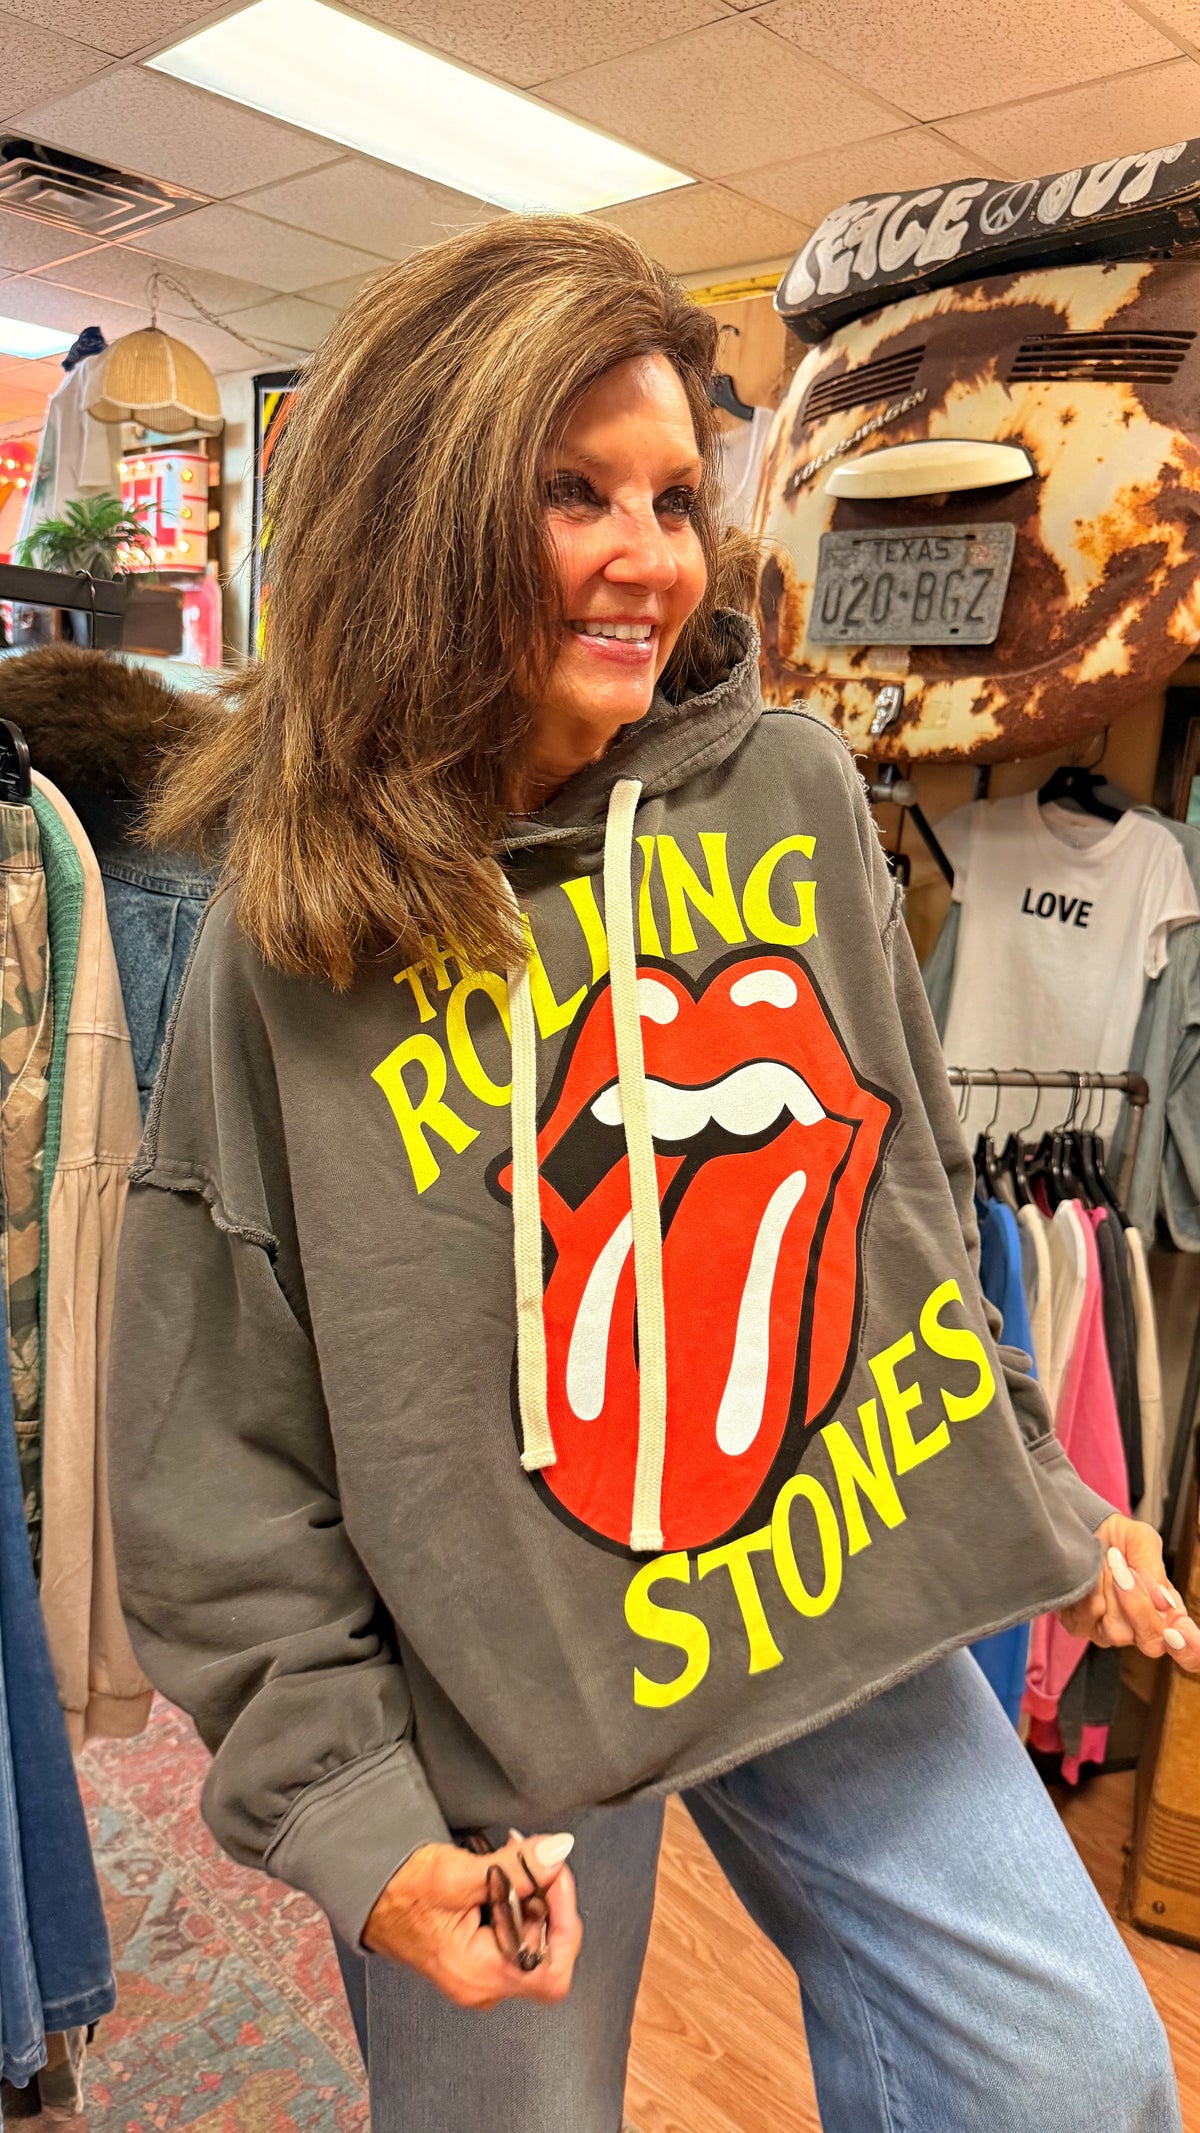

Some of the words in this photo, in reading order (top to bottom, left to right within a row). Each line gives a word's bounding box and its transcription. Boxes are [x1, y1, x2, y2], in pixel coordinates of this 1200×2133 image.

[785, 181, 988, 305] PEACE
[1037, 141, 1187, 225] OUT
[874, 539, 950, 566] TEXAS
[1021, 888, 1093, 928] LOVE
[371, 832, 818, 1194] ROLLING
[393, 926, 486, 1023] TH
[624, 1279, 995, 1707] STONES
